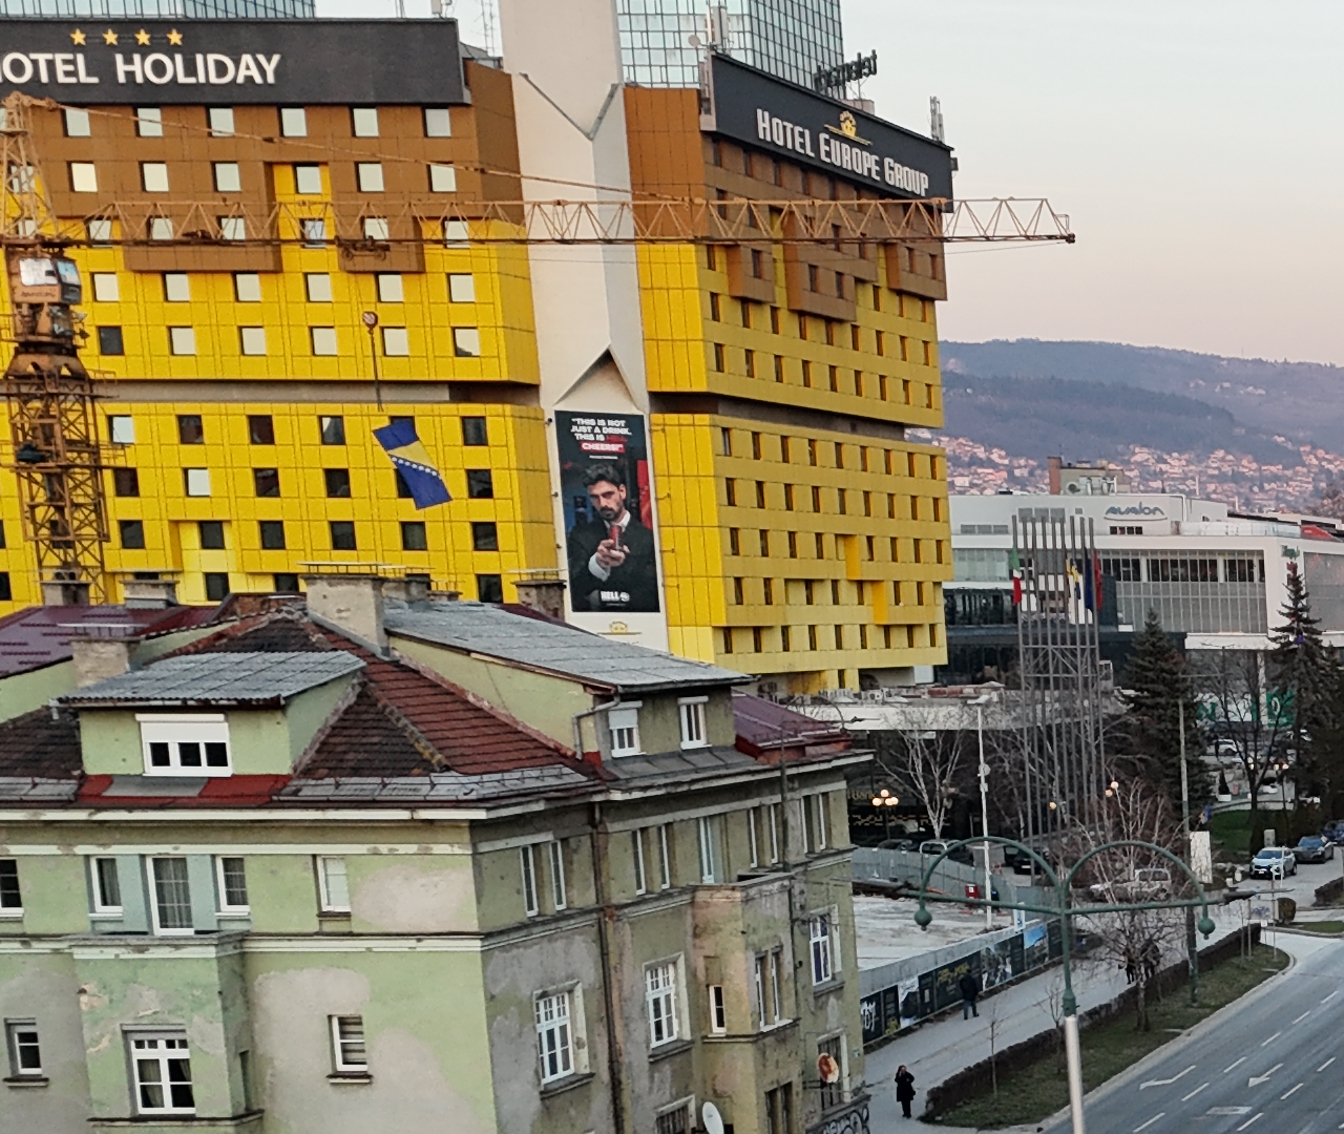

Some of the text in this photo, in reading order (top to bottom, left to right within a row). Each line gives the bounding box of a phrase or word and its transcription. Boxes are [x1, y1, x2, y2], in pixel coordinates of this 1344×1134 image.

[0, 53, 281, 84] OTEL HOLIDAY
[756, 108, 929, 197] HOTEL EUROPE GROUP
